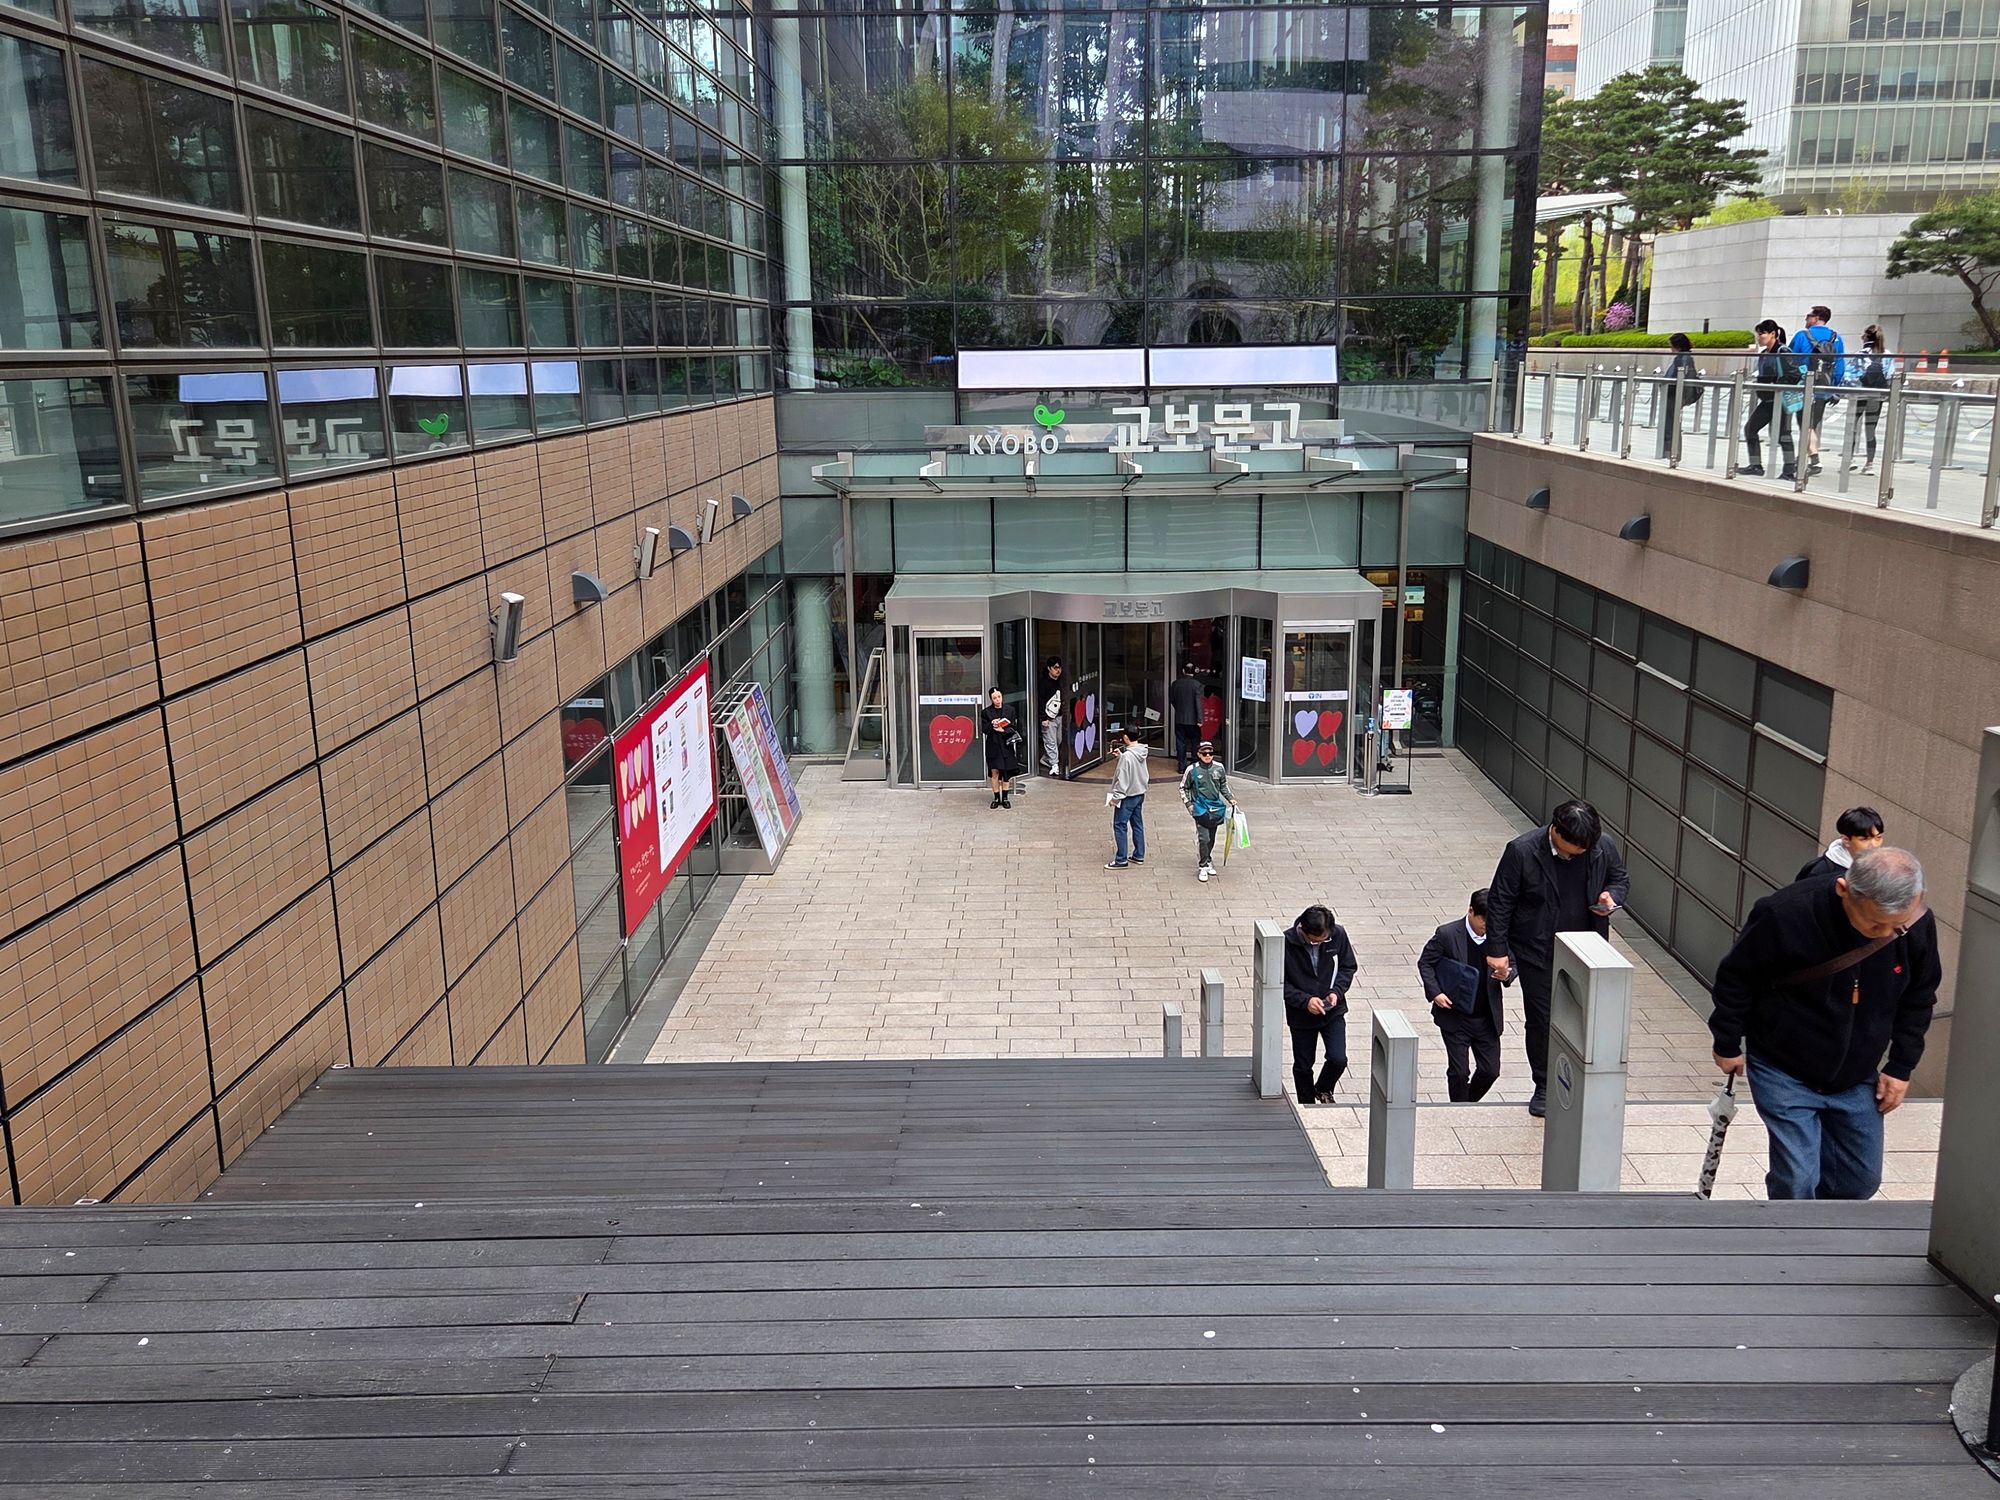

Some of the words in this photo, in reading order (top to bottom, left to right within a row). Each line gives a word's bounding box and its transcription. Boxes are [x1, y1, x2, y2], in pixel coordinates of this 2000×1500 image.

[1109, 403, 1303, 453] 교보문고
[969, 434, 1059, 455] KYOBO
[1103, 600, 1165, 618] 교보문고
